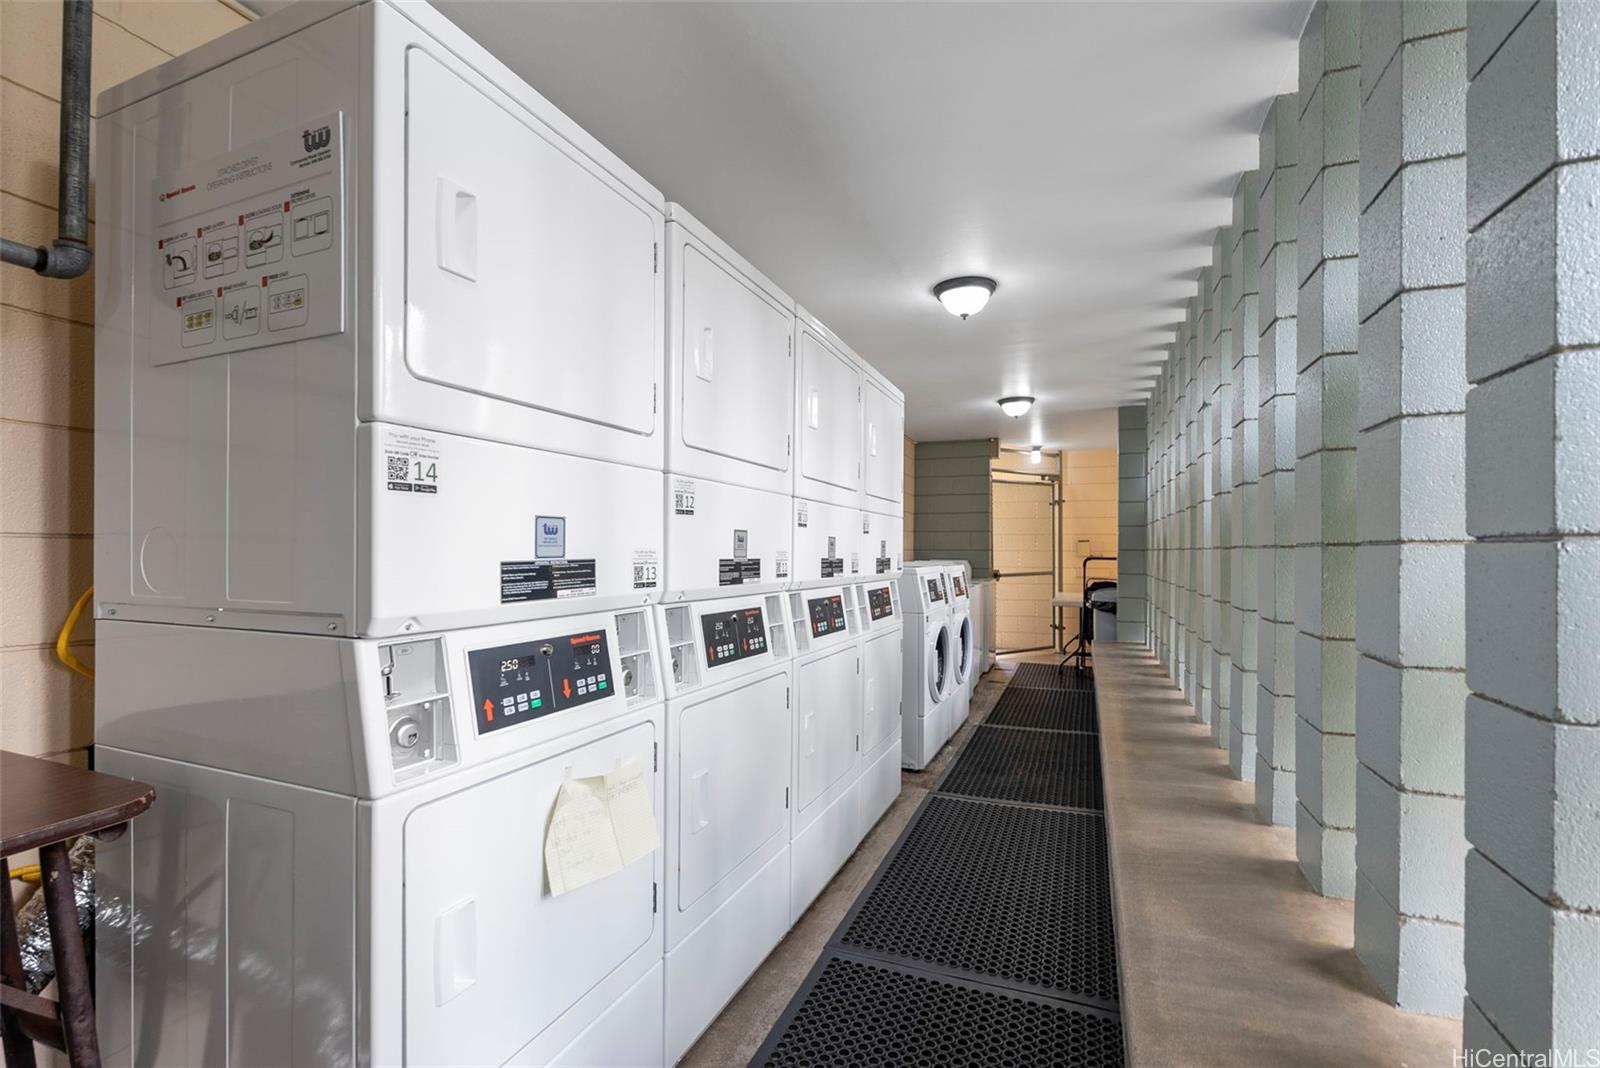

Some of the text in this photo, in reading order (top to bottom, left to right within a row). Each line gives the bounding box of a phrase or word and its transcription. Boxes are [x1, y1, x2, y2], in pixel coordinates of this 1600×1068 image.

[414, 461, 438, 483] 14
[685, 495, 695, 509] 12
[646, 566, 657, 580] 13
